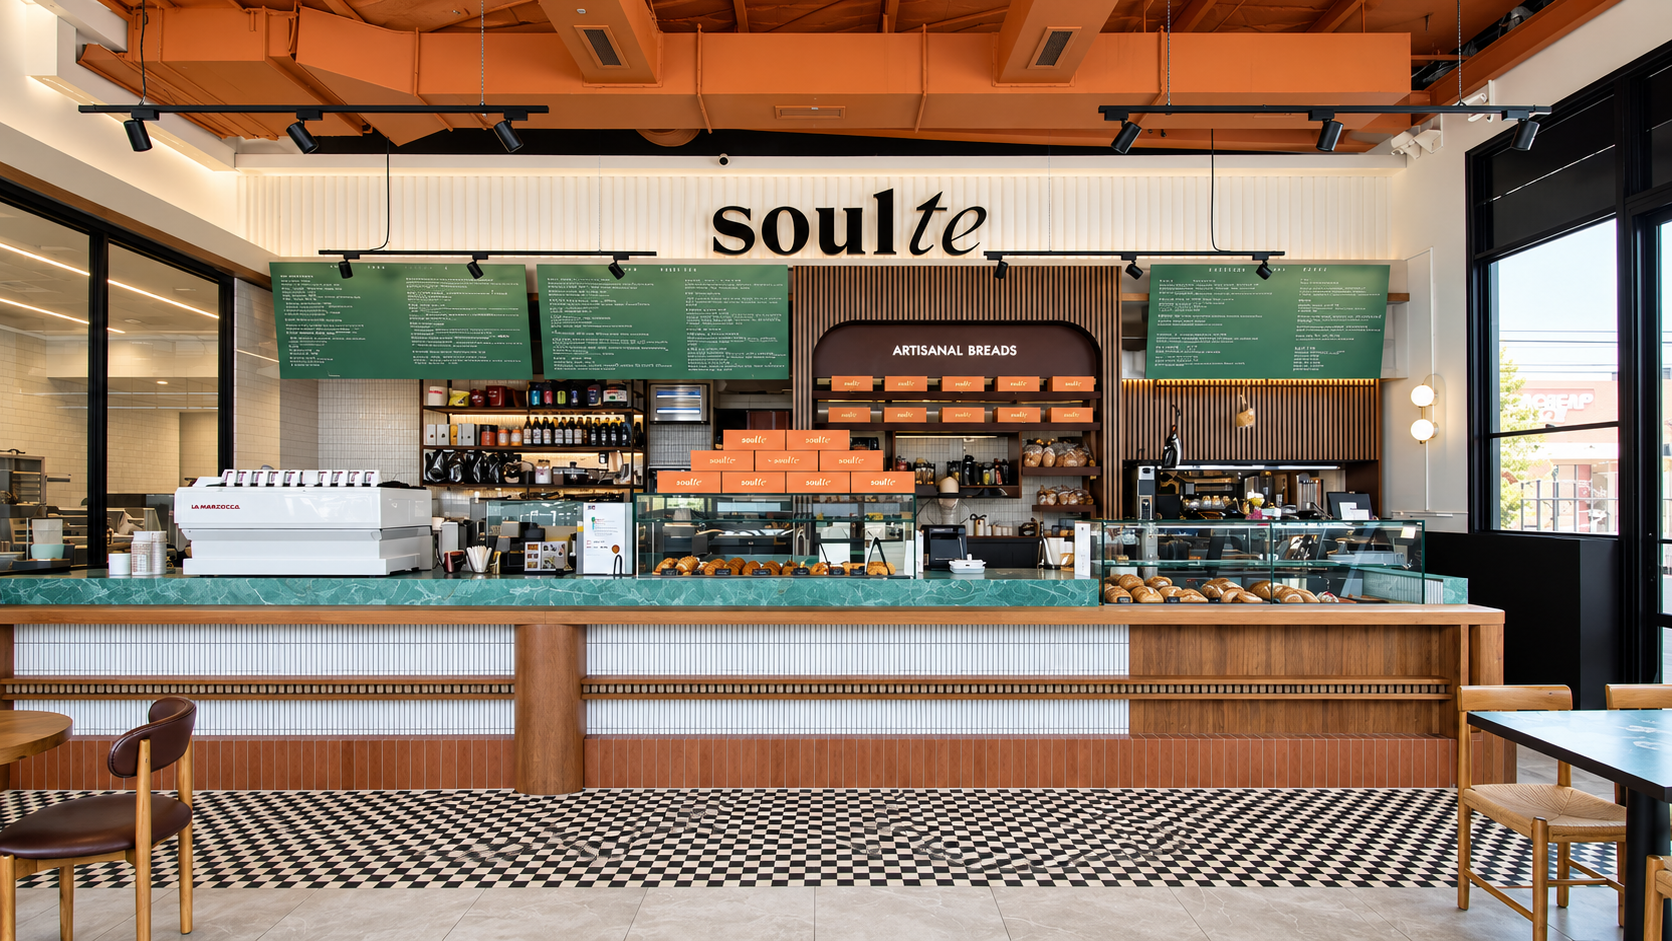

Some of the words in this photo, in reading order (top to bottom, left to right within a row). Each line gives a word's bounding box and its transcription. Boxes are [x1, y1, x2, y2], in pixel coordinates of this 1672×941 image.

[712, 187, 987, 256] soulte
[892, 345, 964, 356] ARTISANAL
[968, 345, 1018, 356] BREADS
